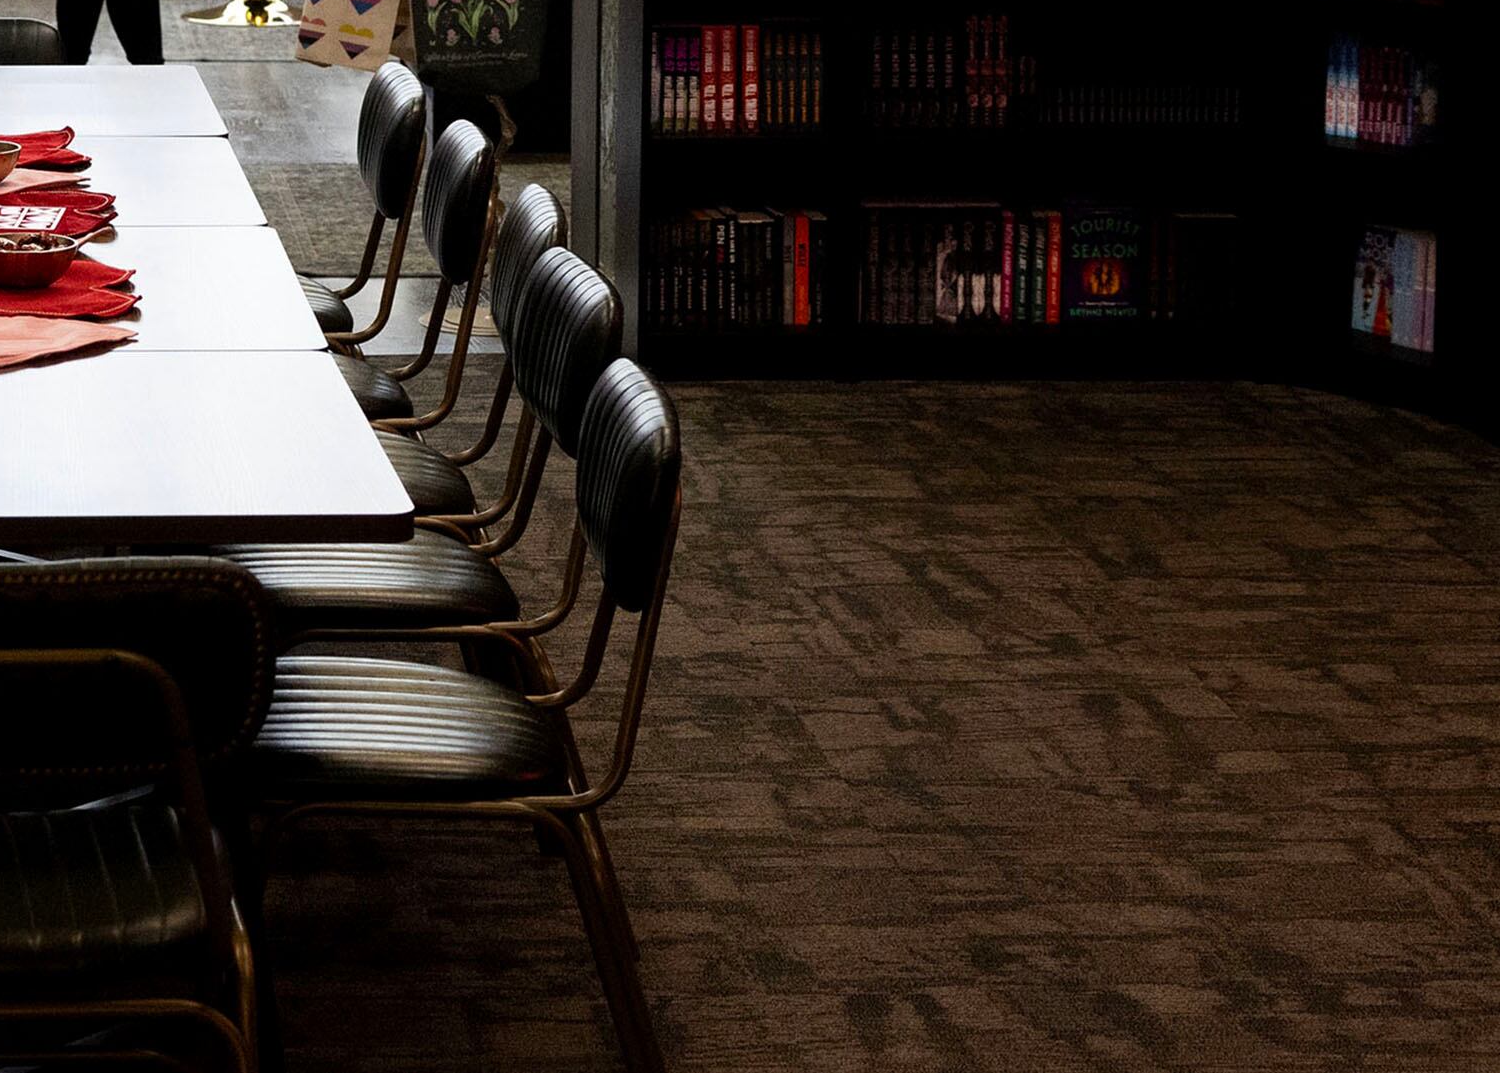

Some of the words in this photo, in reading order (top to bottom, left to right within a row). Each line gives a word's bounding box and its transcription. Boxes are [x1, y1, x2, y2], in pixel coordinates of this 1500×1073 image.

[716, 225, 725, 245] PEN
[1070, 217, 1142, 238] TOURIST
[1071, 243, 1138, 259] SEASON
